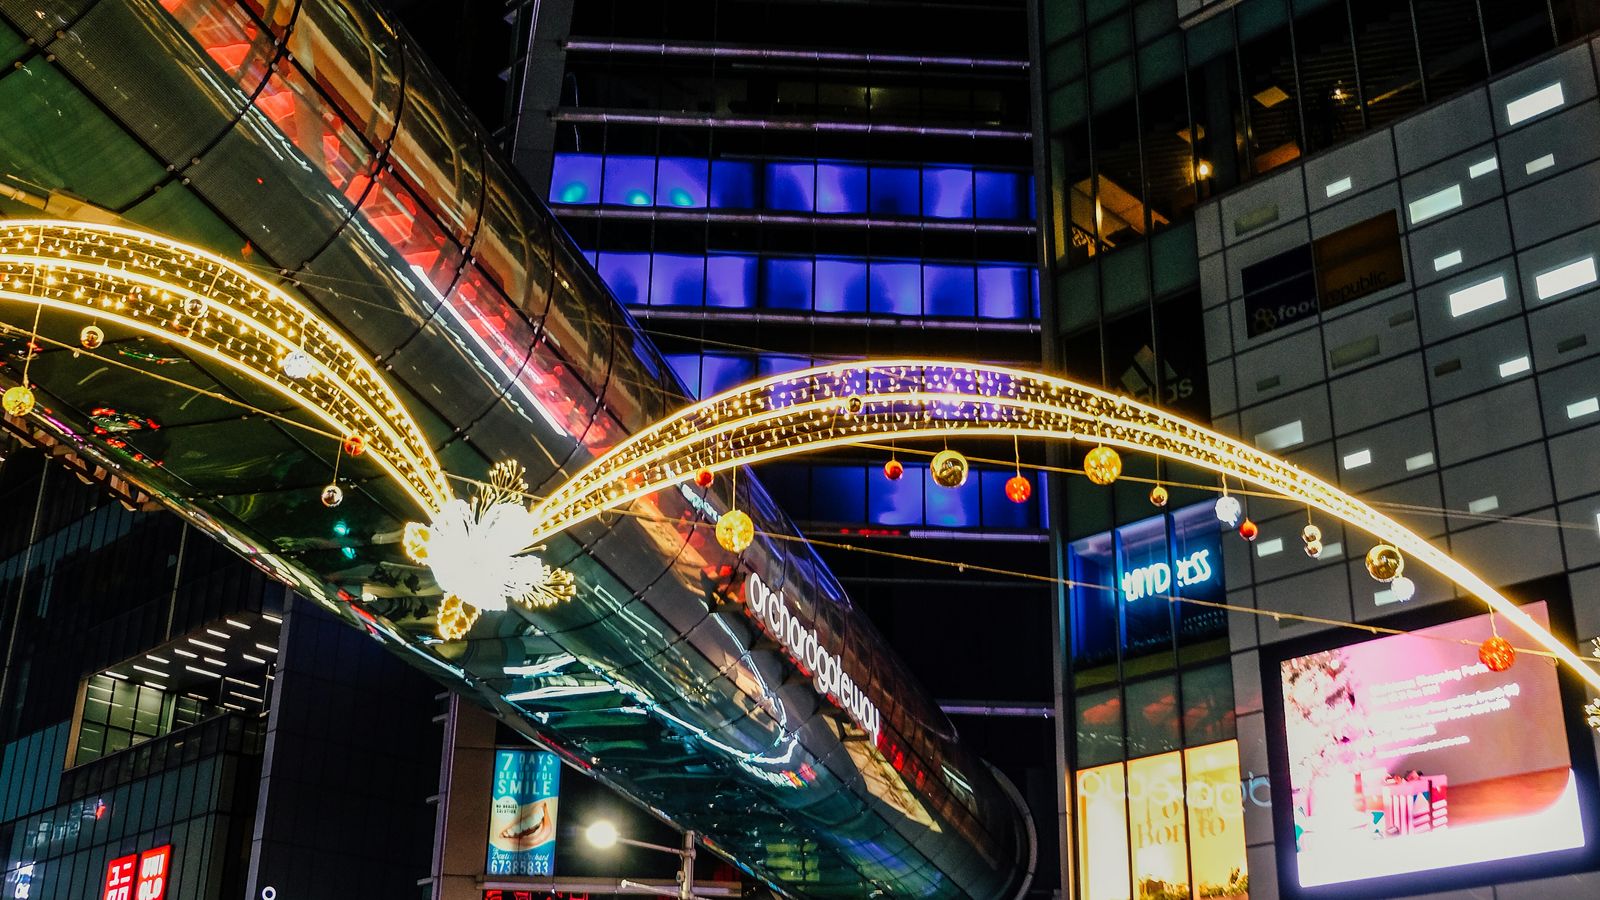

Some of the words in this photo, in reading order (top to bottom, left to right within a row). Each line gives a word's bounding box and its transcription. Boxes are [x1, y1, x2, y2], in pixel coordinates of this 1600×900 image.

[750, 572, 880, 747] orchardgateway
[501, 752, 514, 771] 7
[519, 753, 554, 765] DAYS
[498, 771, 553, 781] BEAUTIFUL
[497, 779, 552, 796] SMILE
[142, 853, 165, 879] UNI
[491, 860, 549, 875] 67385833
